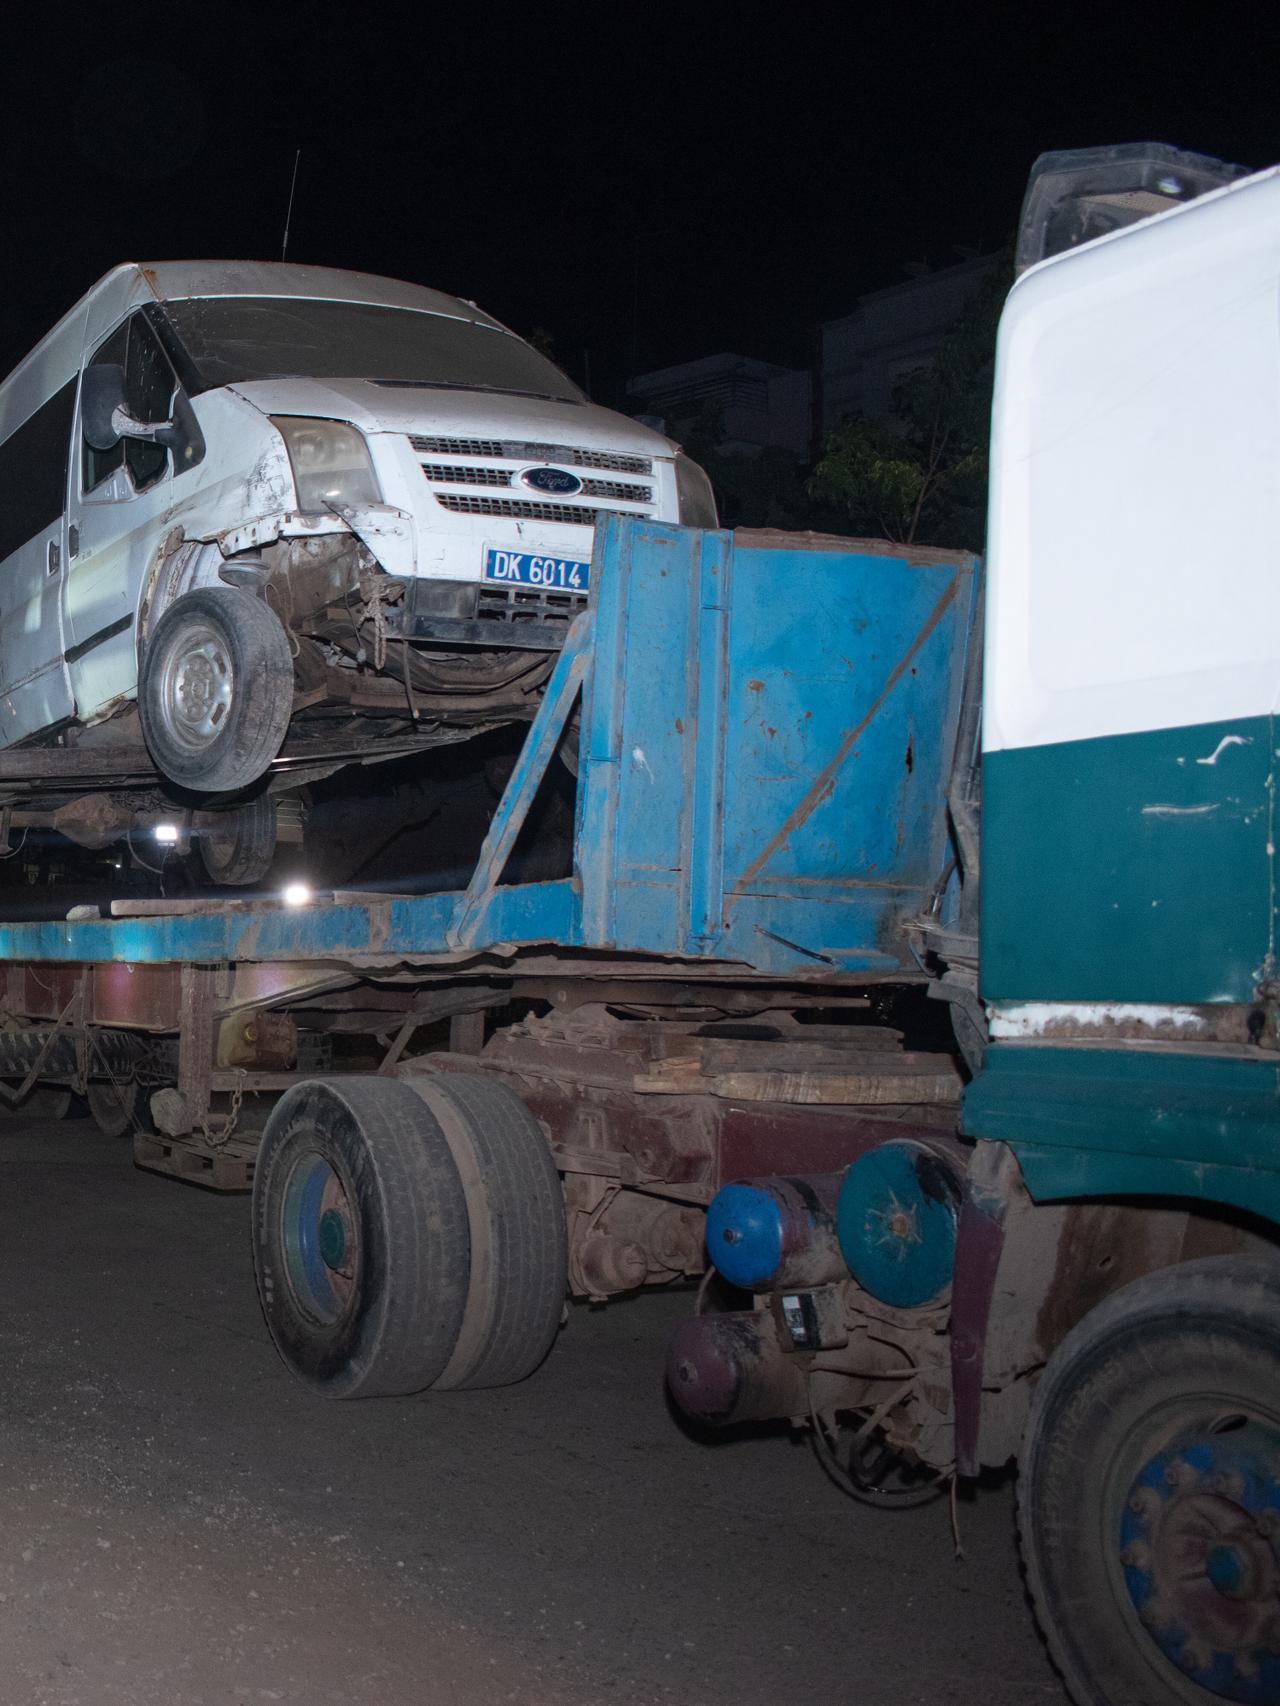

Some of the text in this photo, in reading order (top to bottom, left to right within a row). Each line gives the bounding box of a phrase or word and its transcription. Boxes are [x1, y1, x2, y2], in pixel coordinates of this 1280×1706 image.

[537, 470, 570, 489] Ford
[493, 551, 582, 588] DK 6014
